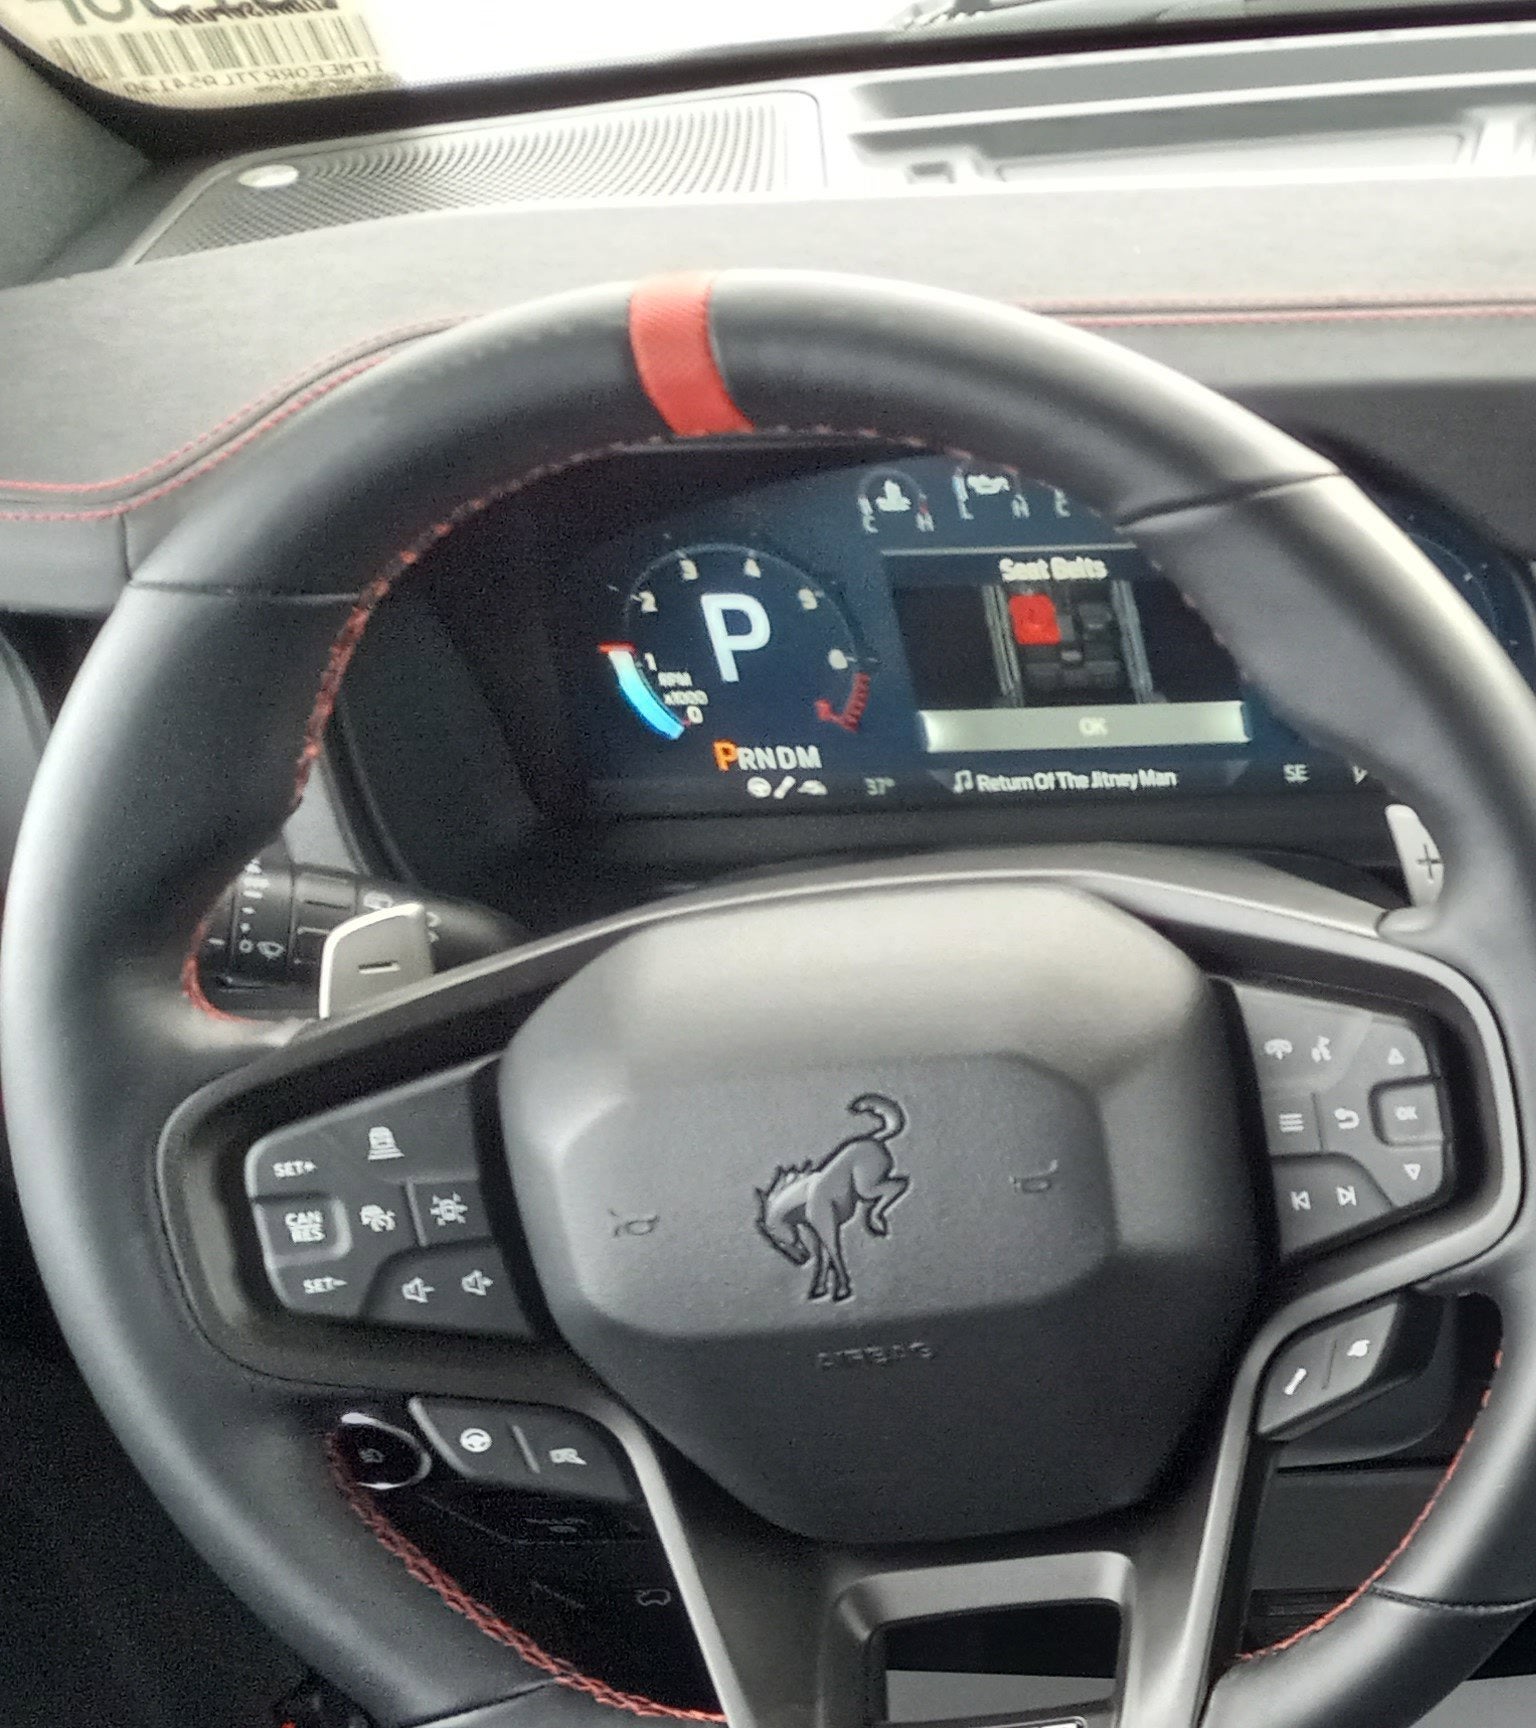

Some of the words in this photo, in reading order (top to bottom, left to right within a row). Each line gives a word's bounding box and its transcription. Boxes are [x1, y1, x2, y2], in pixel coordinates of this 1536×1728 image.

[680, 558, 698, 581] 3
[744, 558, 761, 578] 4
[999, 557, 1050, 582] Seat
[1050, 555, 1109, 581] Belts
[641, 591, 658, 612] 2
[701, 593, 771, 683] P
[686, 706, 703, 724] 0
[1078, 716, 1107, 736] OK
[976, 772, 1032, 792] Return
[1033, 773, 1053, 791] Of
[1055, 771, 1088, 790] The
[1088, 770, 1139, 792] Jitney
[1140, 769, 1178, 787] Man
[1283, 763, 1310, 784] SE
